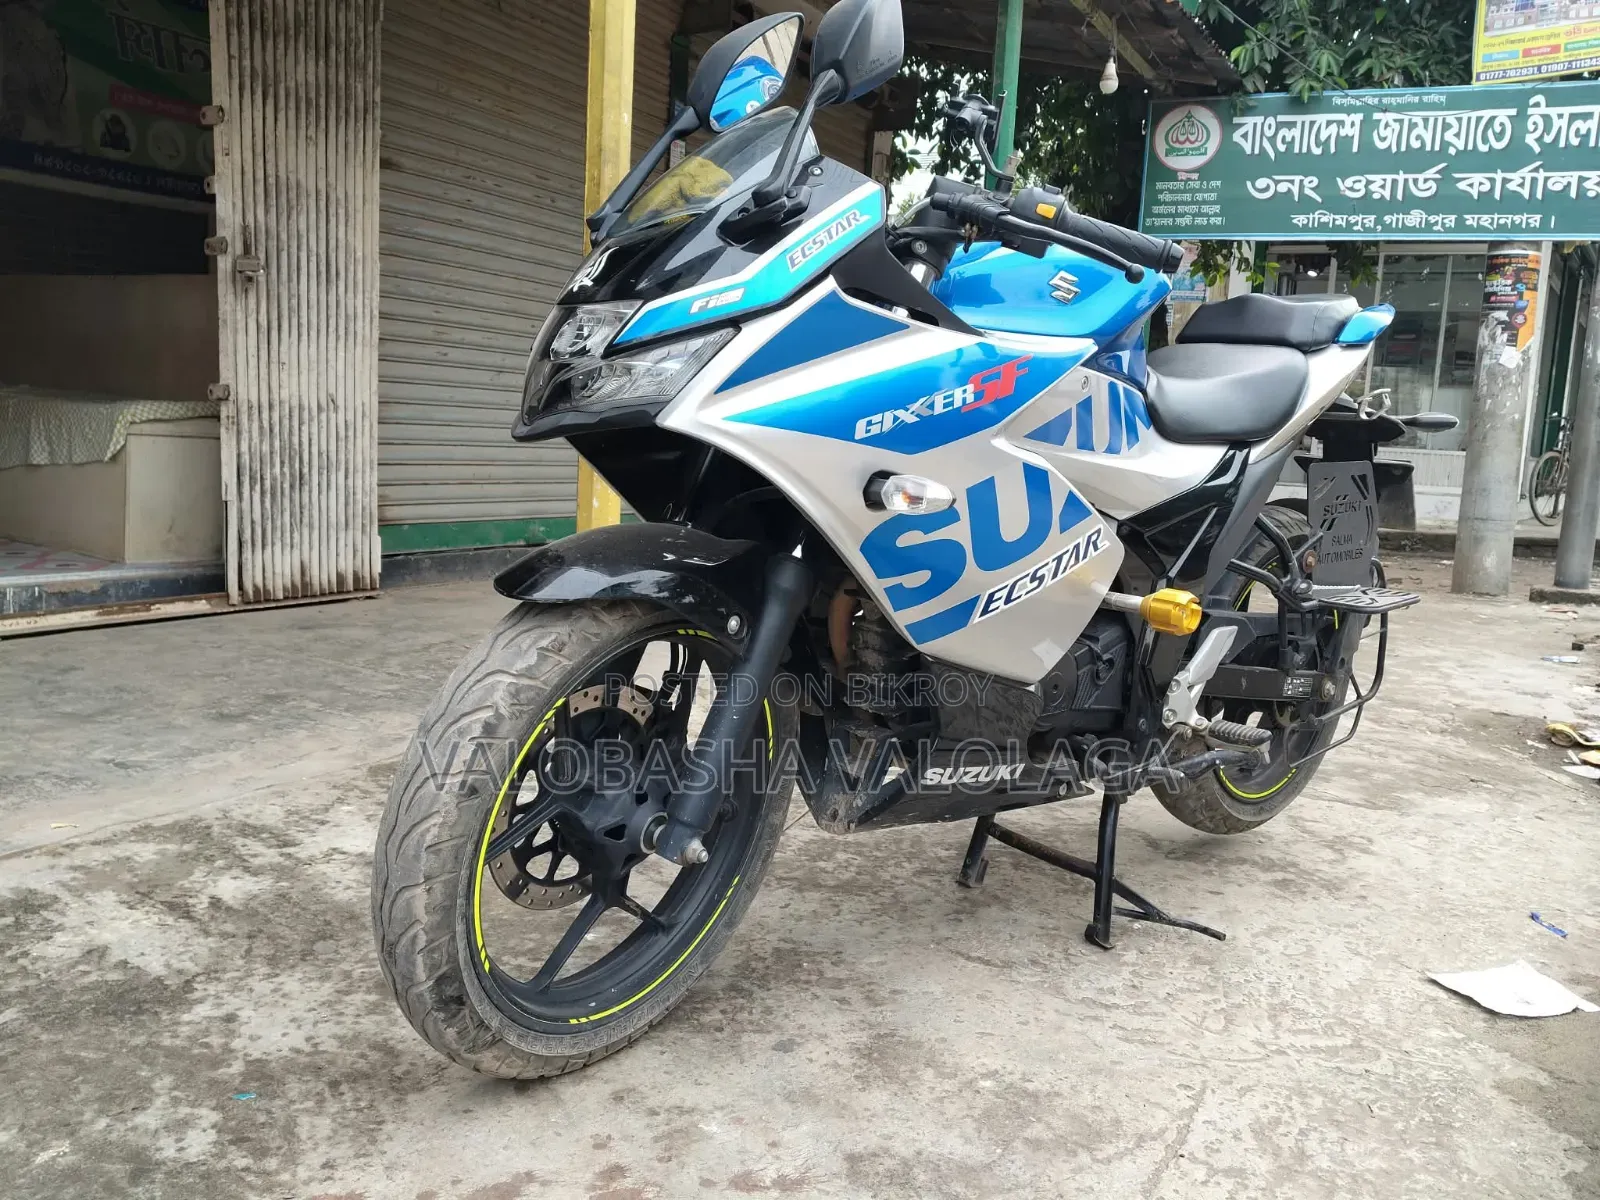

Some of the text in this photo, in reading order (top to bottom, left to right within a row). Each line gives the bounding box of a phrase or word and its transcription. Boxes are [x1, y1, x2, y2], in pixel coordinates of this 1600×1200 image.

[1232, 94, 1600, 162] বাংলাদেশ জামায়াতে ইসল
[1246, 175, 1322, 203] ৩নং
[1336, 163, 1448, 201] ওয়ার্ড
[787, 210, 864, 270] ECSTAR
[961, 354, 1034, 413] SF
[1323, 500, 1362, 517] SUZUKI
[977, 526, 1106, 619] ECSTAR
[920, 763, 1026, 785] SUZUKI
